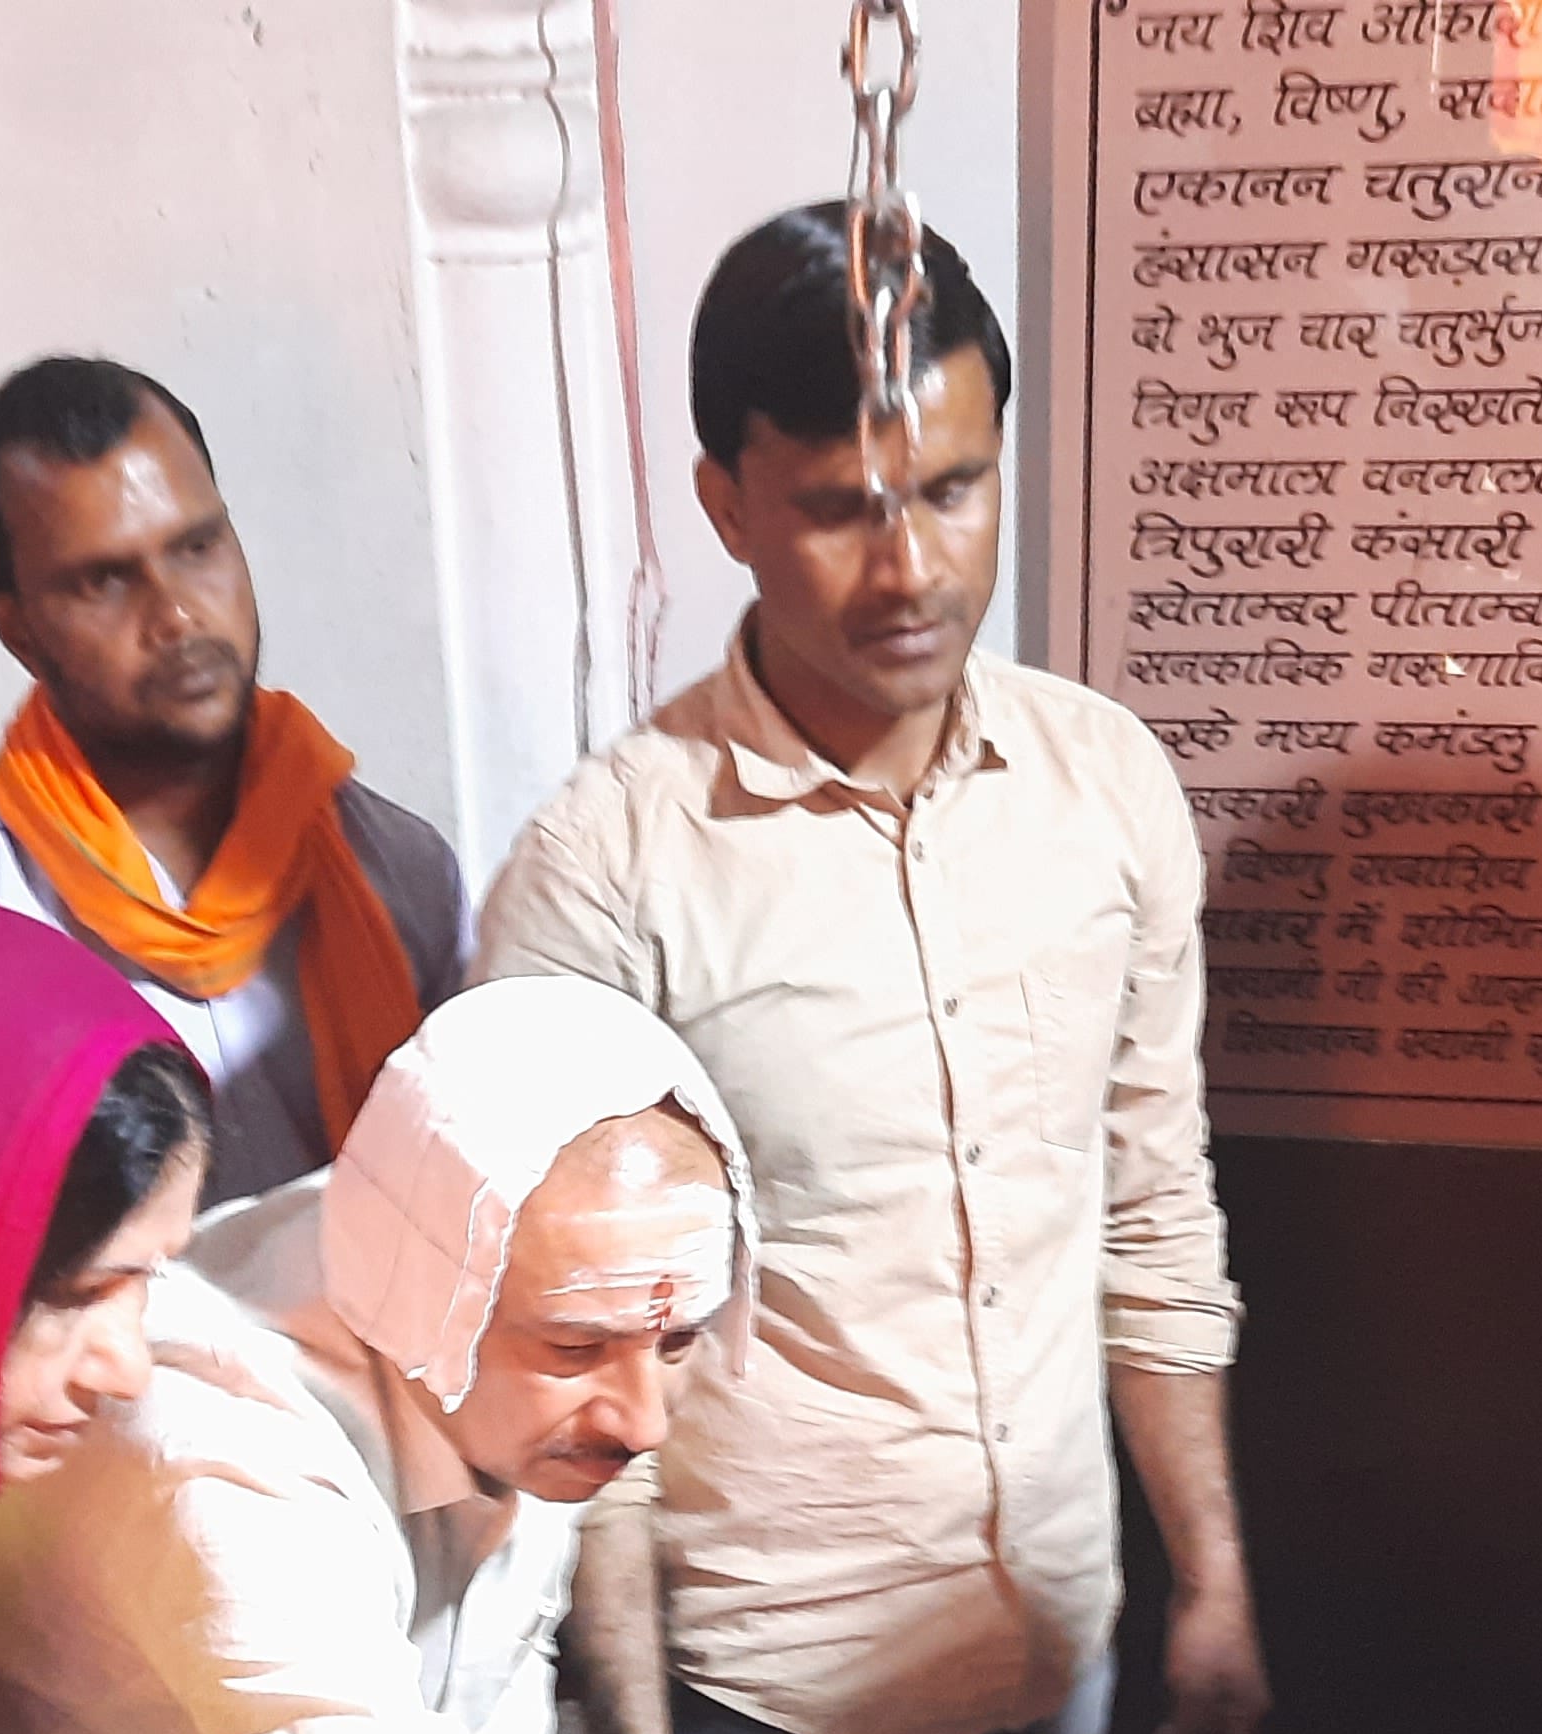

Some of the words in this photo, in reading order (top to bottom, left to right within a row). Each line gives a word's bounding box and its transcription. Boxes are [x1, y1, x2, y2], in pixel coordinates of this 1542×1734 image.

[1134, 11, 1224, 52] जय
[1133, 165, 1345, 215] एकानन
[1132, 227, 1327, 288] हंसासन
[1131, 302, 1181, 355] दो
[1197, 312, 1283, 371] भुज
[1299, 311, 1387, 360] चार
[1274, 388, 1358, 430] रूप
[1130, 458, 1347, 498] अक्षमाला
[1128, 511, 1334, 578] त्रिपुरारी
[1351, 509, 1536, 569] कंसारी
[1126, 638, 1353, 687] सनकादिक
[1255, 719, 1361, 755] मध्य
